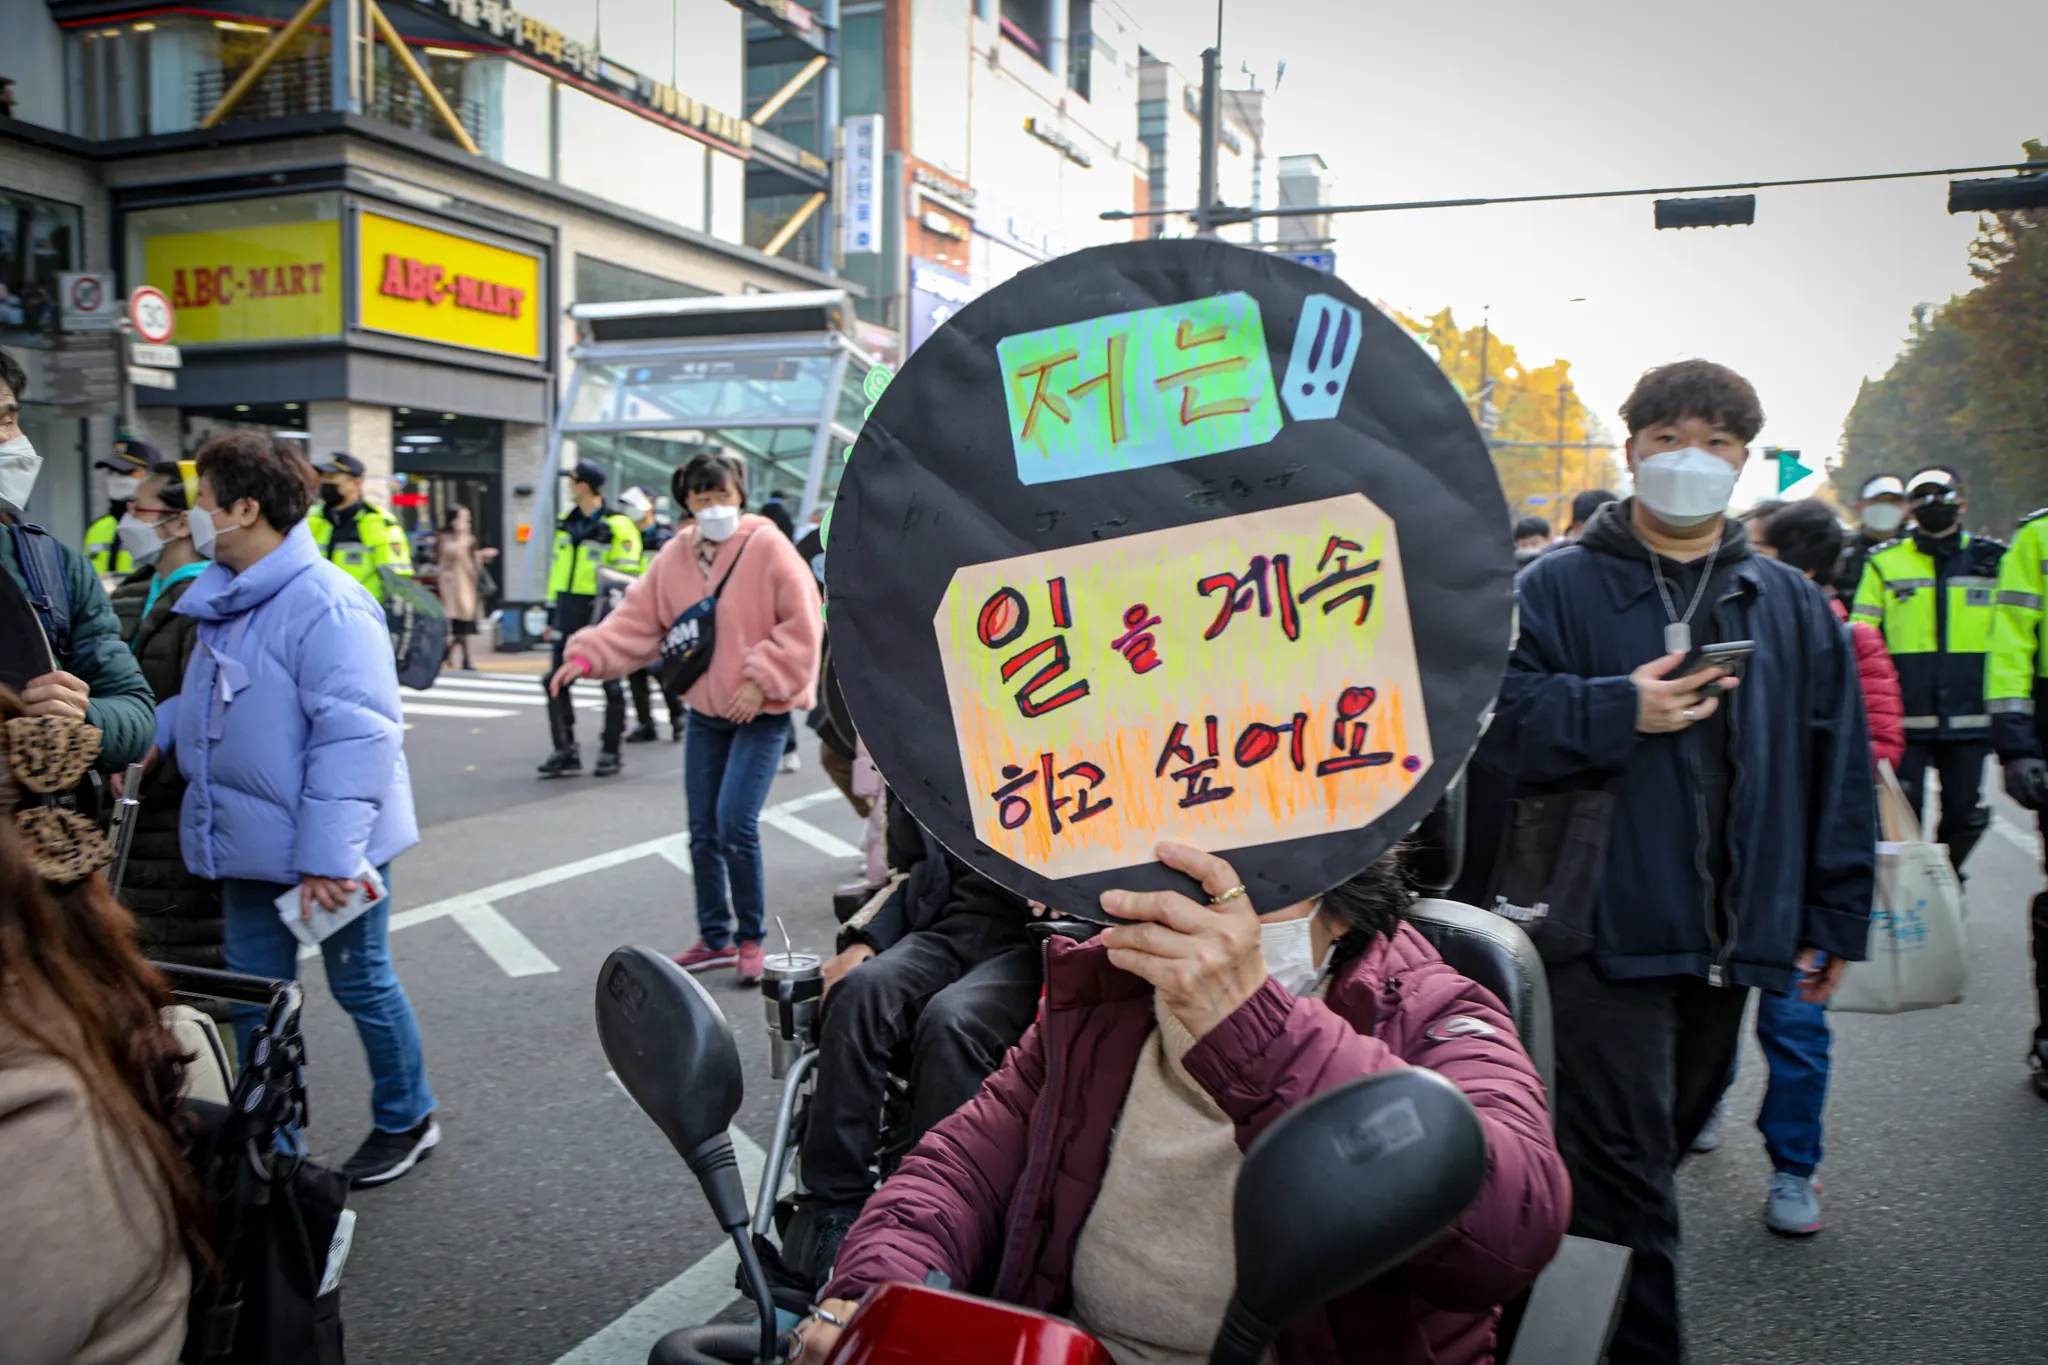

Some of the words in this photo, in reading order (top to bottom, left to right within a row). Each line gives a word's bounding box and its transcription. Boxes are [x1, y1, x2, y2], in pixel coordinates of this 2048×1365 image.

[173, 263, 324, 309] ABC-MART
[380, 252, 525, 318] ABC-MART
[1017, 316, 1252, 446] 저는
[1197, 534, 1382, 642] 계속
[990, 751, 1114, 834] 하고
[1154, 686, 1423, 809] 싶어요.
